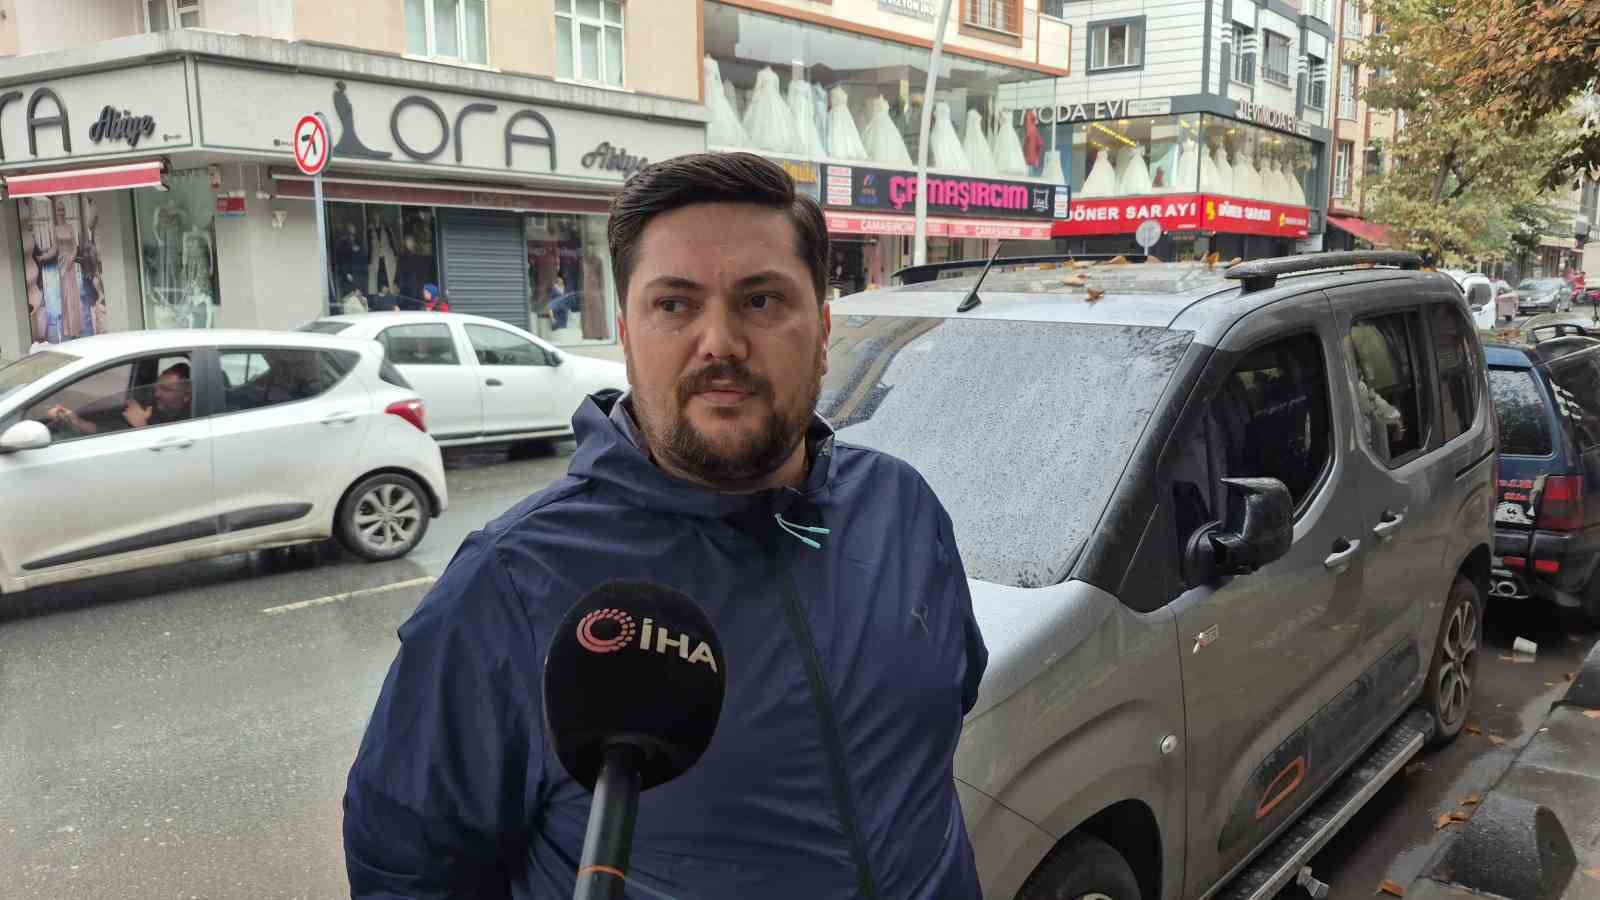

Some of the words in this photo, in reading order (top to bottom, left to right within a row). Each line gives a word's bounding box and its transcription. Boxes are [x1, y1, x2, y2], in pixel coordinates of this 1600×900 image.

[889, 175, 1029, 212] ÇAMAŞIRCIM
[1126, 202, 1197, 220] SARAYI
[639, 617, 718, 673] İHA
